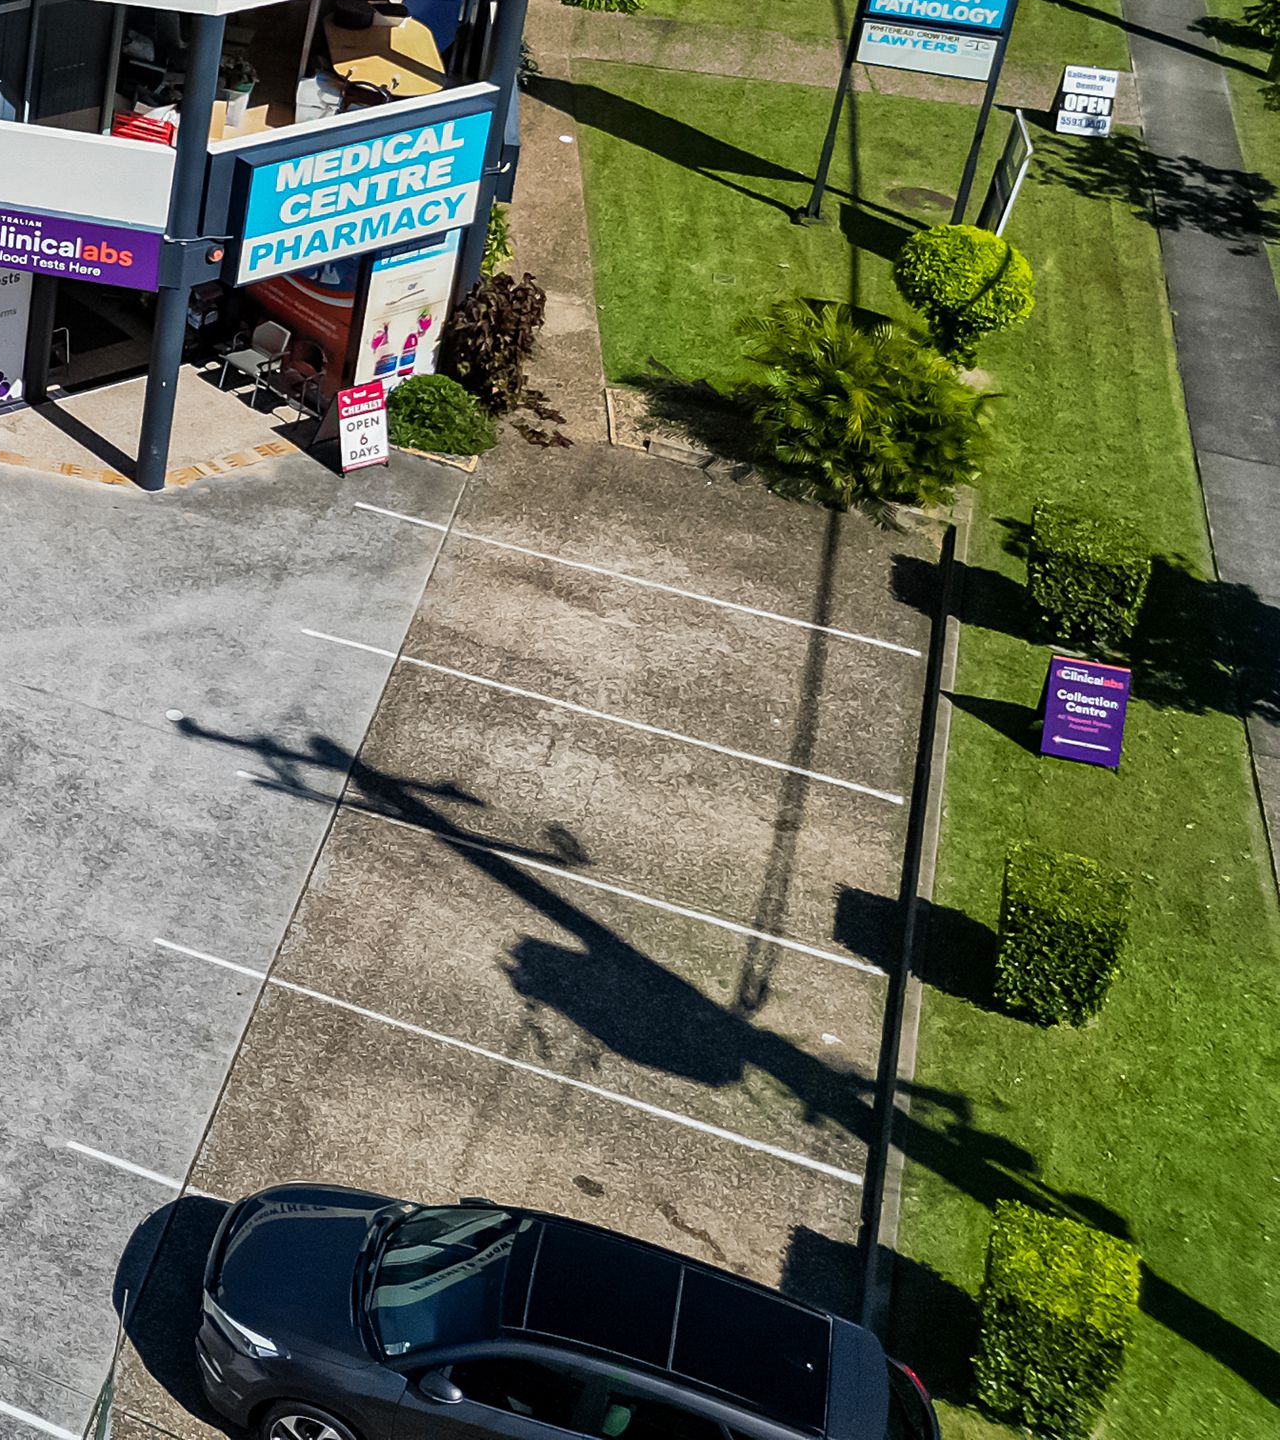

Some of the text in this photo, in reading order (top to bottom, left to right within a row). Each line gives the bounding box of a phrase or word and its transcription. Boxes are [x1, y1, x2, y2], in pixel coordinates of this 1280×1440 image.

[867, 33, 959, 54] LAWYERS
[869, 24, 960, 43] WHITEHEAD CROWTHER
[1064, 93, 1111, 116] OPEN
[275, 121, 465, 192] MEDICAL
[279, 155, 455, 224] CENTRE
[248, 191, 469, 272] PHARMACY
[31, 255, 66, 272] Tests
[69, 261, 102, 277] Here
[346, 416, 380, 433] OPEN
[359, 432, 368, 446] 6
[350, 444, 380, 461] DAYS
[1056, 688, 1119, 711] Collection
[1065, 702, 1108, 719] Centre
